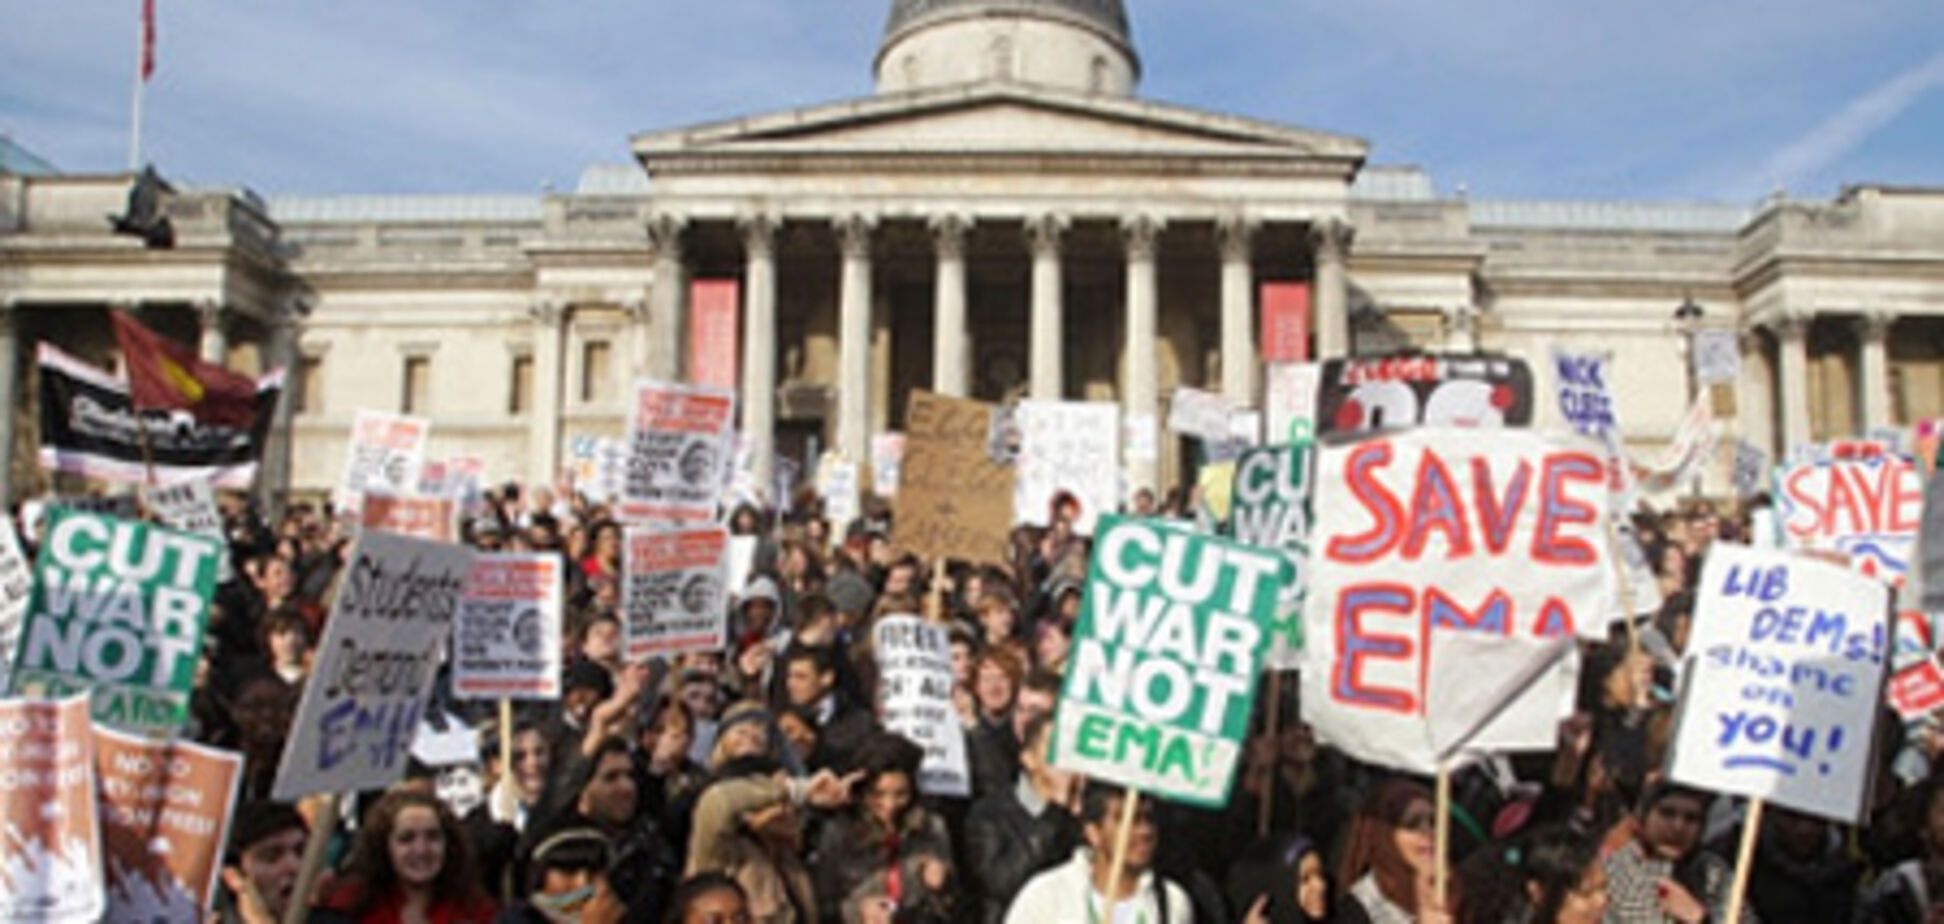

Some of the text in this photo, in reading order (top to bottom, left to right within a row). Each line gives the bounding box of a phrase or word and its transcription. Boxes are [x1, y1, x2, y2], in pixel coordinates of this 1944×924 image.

[1238, 447, 1309, 506] CU
[1325, 441, 1604, 565] SAVE
[1786, 458, 1922, 538] SAVE
[51, 513, 215, 589] CUT
[1233, 500, 1309, 546] WA
[1100, 523, 1279, 615] CUT
[1722, 563, 1788, 601] LIB
[45, 566, 203, 653] WAR
[1092, 580, 1261, 677] WAR
[24, 613, 194, 688] NOT
[1068, 638, 1246, 736] NOT
[1075, 714, 1215, 789] EMA!
